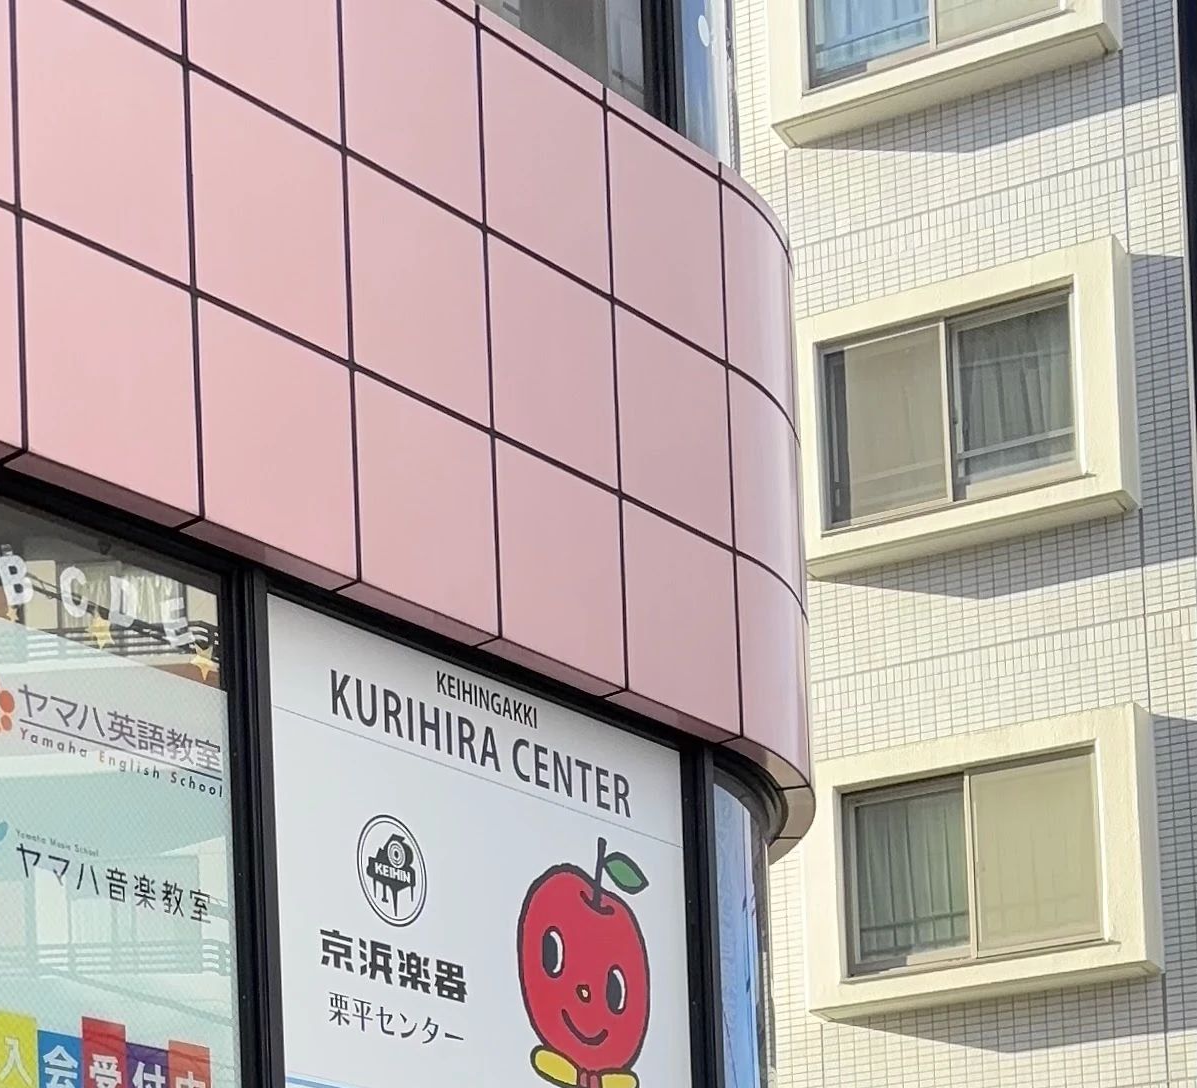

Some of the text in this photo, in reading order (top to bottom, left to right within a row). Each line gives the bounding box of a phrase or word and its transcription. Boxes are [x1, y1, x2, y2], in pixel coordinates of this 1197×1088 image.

[60, 566, 89, 618] C
[18, 684, 222, 772] ヤマハ英語教室
[436, 670, 538, 729] KEIHINGAKKI
[20, 727, 223, 798] Yamaha English School
[330, 669, 631, 819] KURIHIRA CENTER
[16, 843, 212, 924] ヤマハ音楽教室
[374, 861, 412, 883] KEIHIN
[320, 929, 468, 1004] 京浜楽器
[328, 991, 465, 1046] 栗平センター
